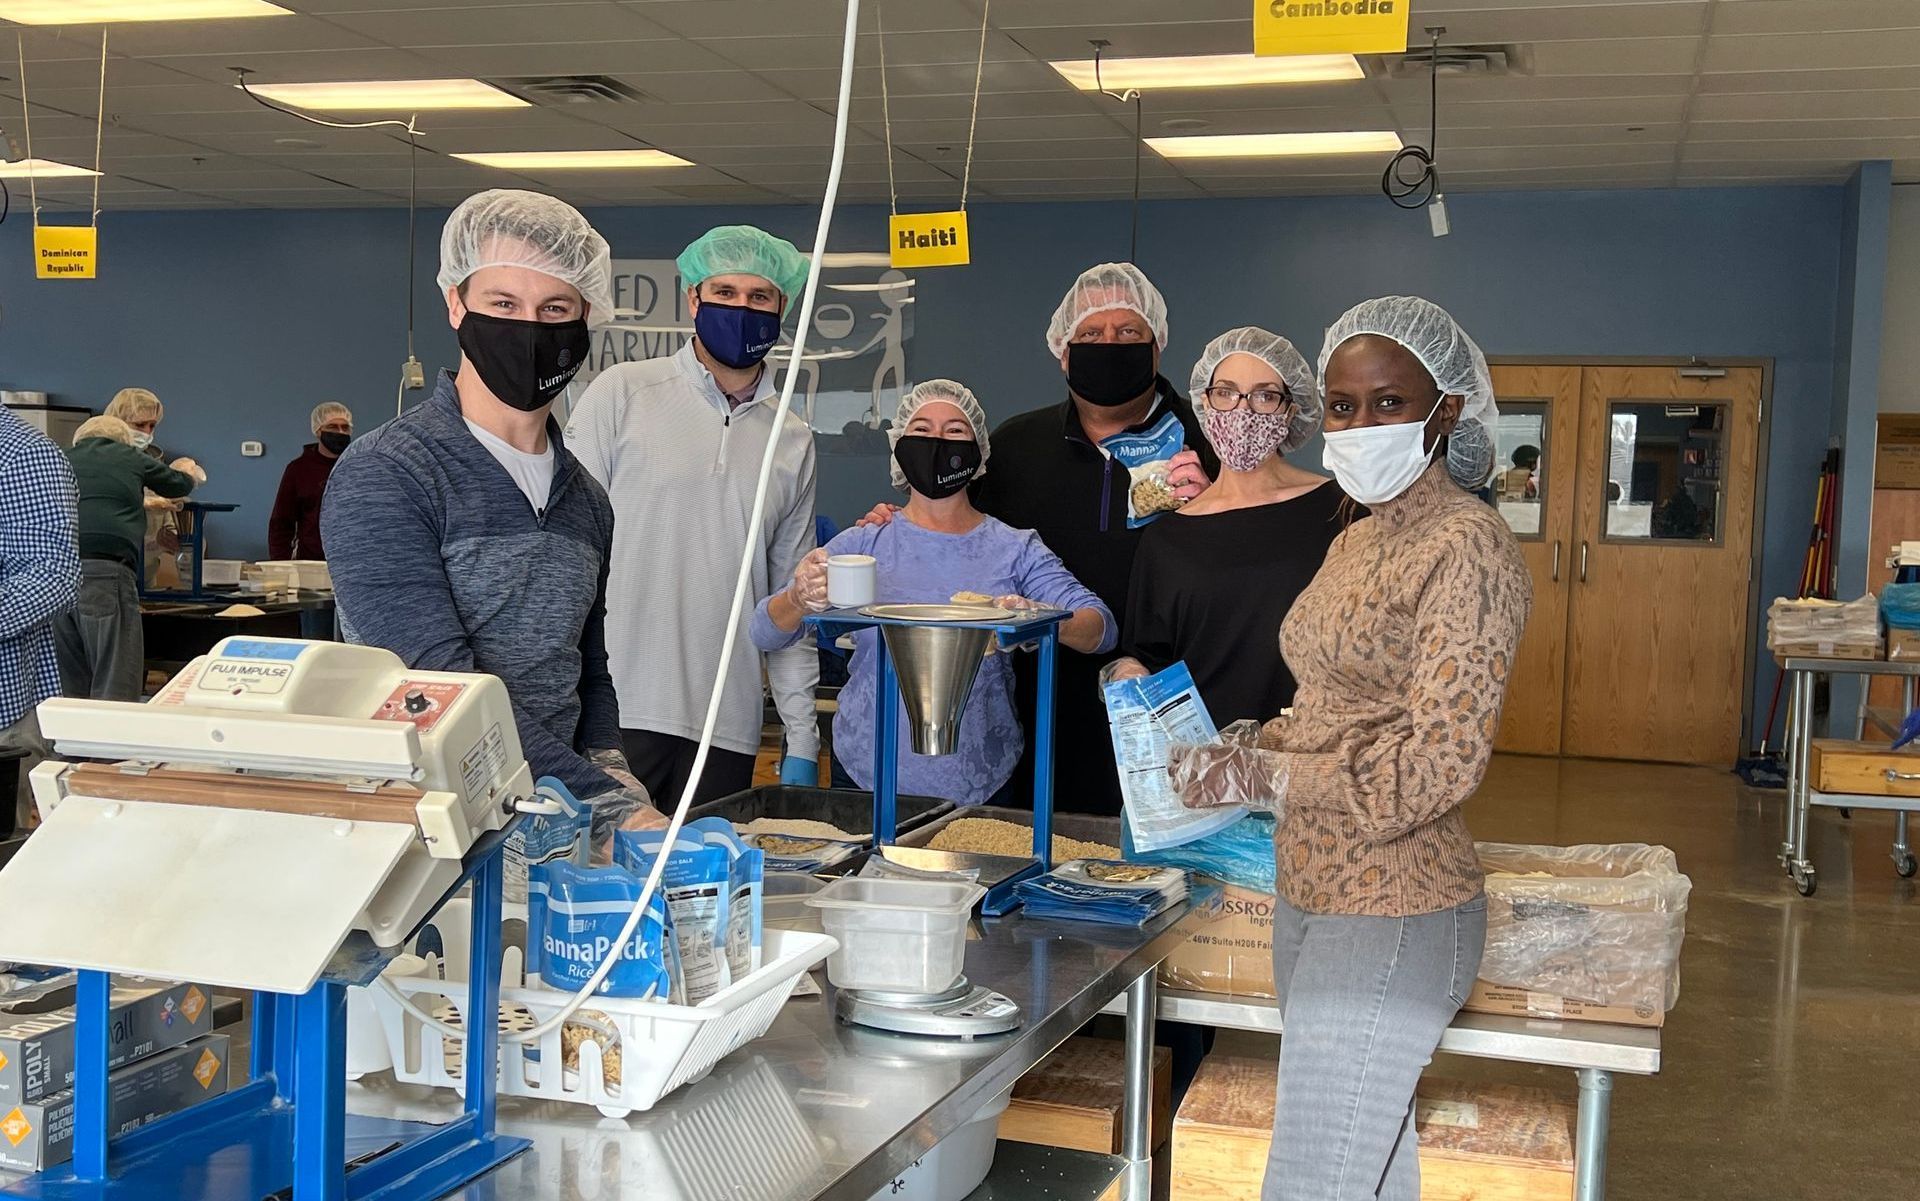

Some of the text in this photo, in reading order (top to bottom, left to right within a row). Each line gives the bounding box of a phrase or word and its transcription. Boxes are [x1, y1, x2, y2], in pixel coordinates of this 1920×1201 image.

[1270, 0, 1393, 18] Cambodia
[899, 227, 956, 248] Haiti
[42, 249, 88, 257] Dominican
[47, 264, 84, 274] Republic
[614, 274, 658, 321] ED
[1120, 444, 1158, 457] Manna
[211, 664, 288, 677] FUJI IMPULSE
[1221, 900, 1275, 916] SSRO
[544, 934, 649, 963] annaPck
[1235, 939, 1256, 948] H206
[134, 1041, 153, 1057] P2101
[26, 1041, 43, 1086] POLY
